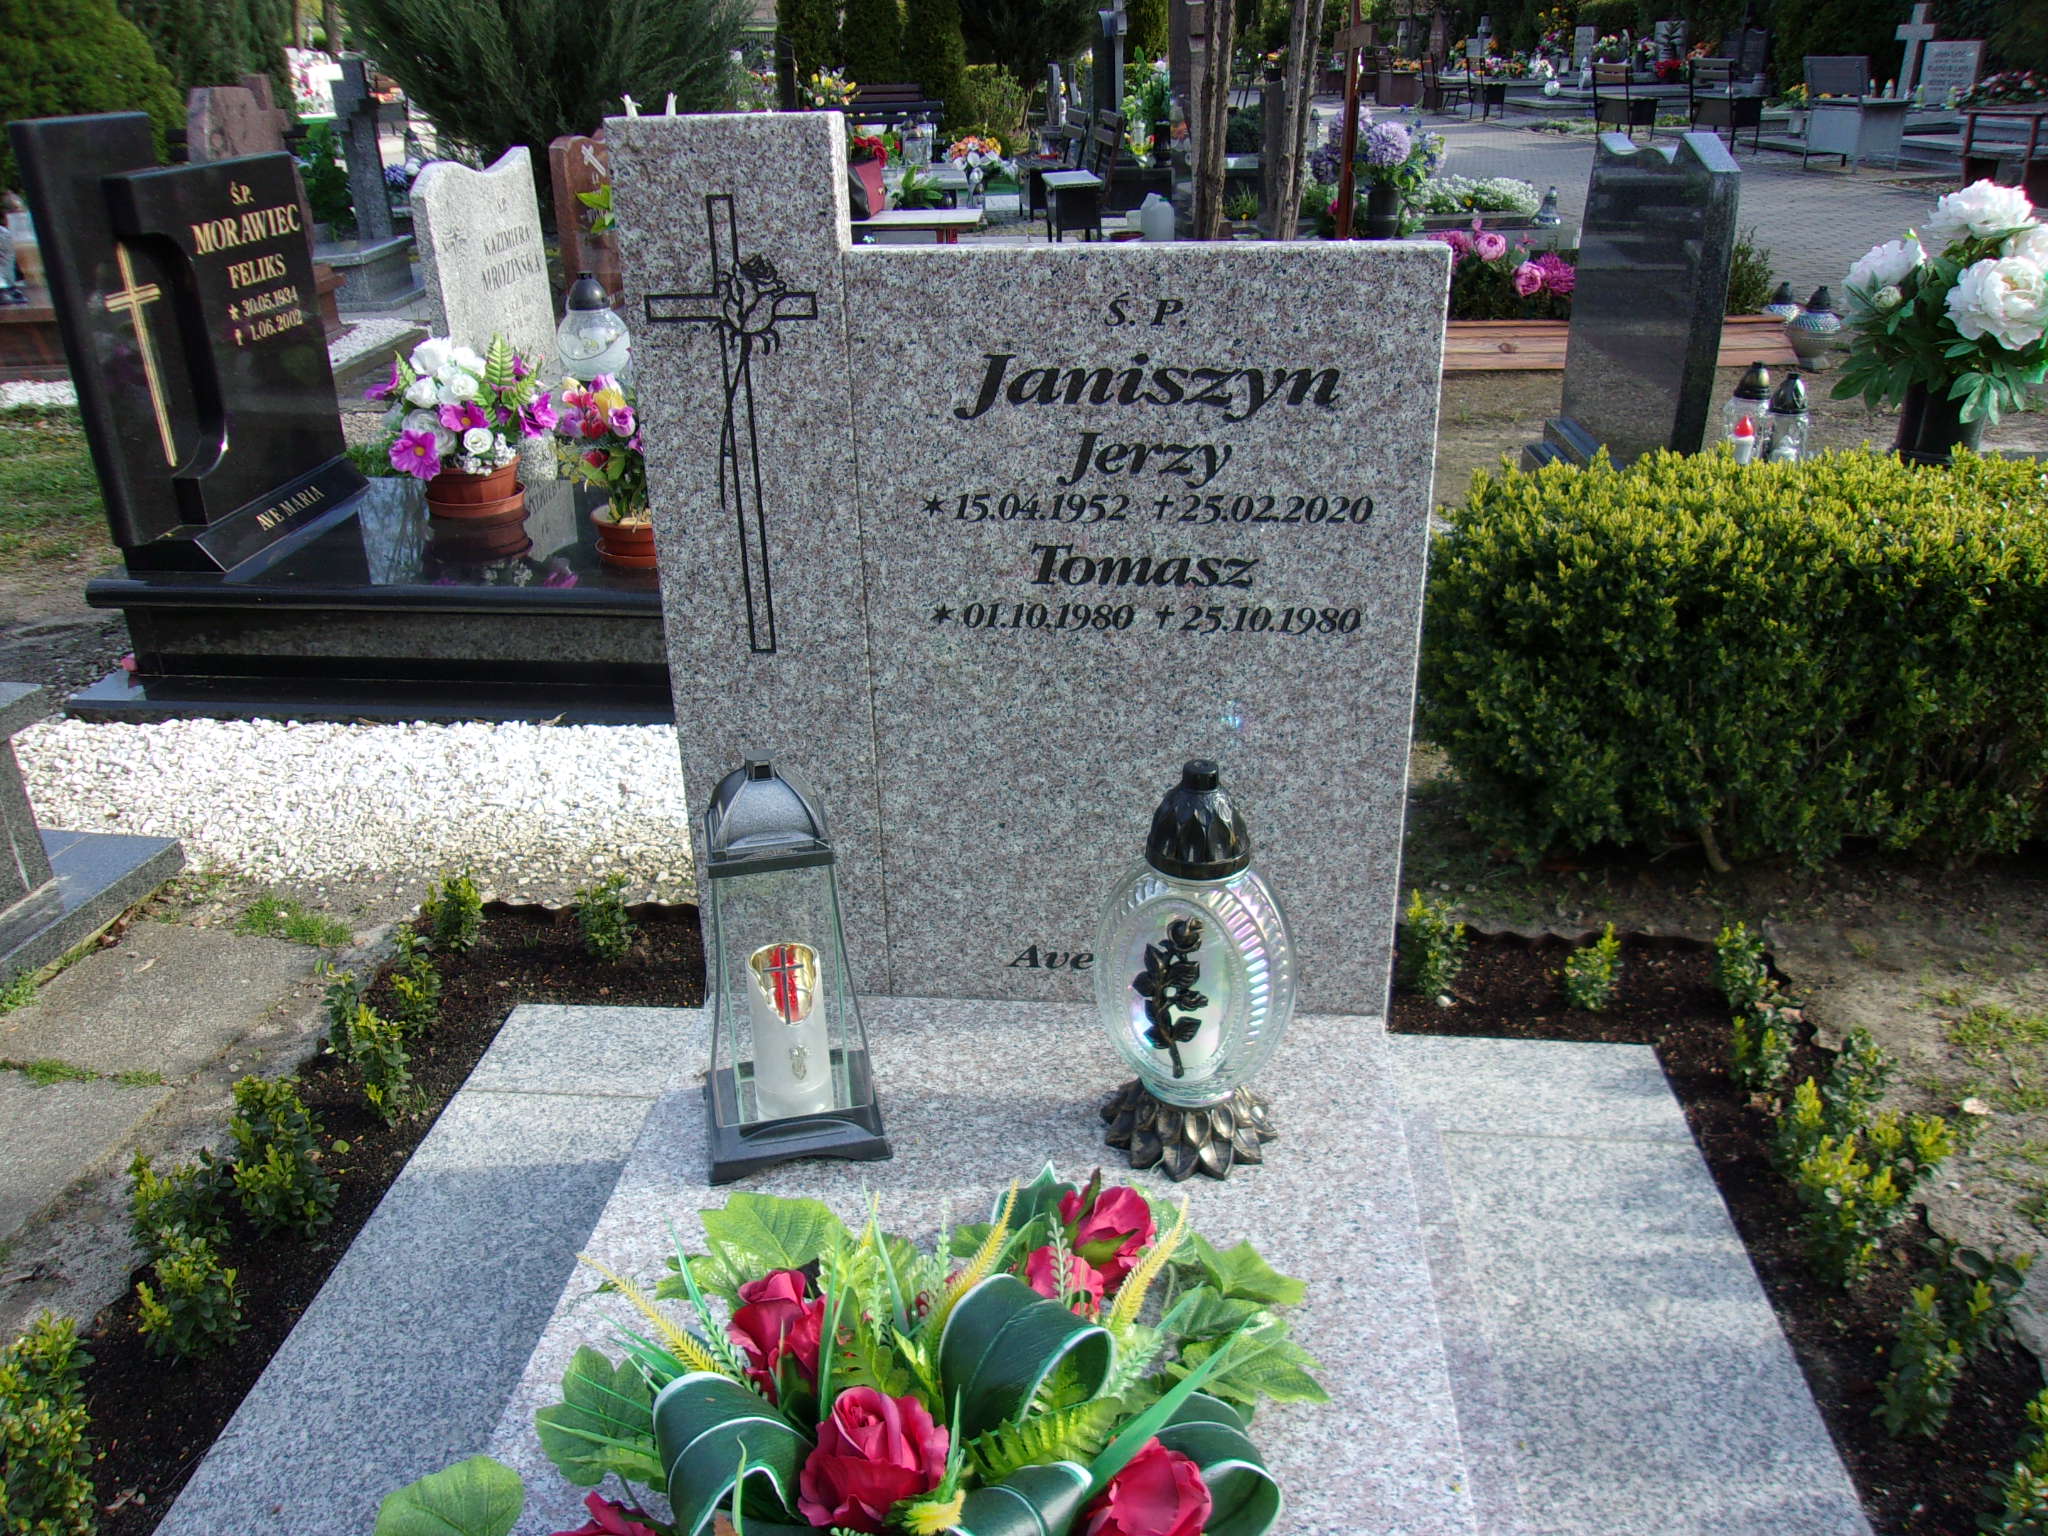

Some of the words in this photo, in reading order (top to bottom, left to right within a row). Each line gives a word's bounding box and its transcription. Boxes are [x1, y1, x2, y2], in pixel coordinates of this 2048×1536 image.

[191, 204, 301, 255] MORAWIEC
[227, 253, 287, 289] FELIKS
[249, 309, 304, 341] 1.06.2002
[953, 352, 1340, 423] Janiszyn
[1056, 432, 1233, 488] Jerzy
[256, 506, 285, 532] AVE
[278, 485, 325, 517] MARIA
[953, 493, 1130, 524] 15.04.1952
[1179, 494, 1374, 526] 25.02.2020
[1031, 543, 1260, 588] Tomasz
[962, 601, 1135, 631] 01.10.1980
[1183, 605, 1362, 635] 25.10.1980
[1005, 944, 1094, 970] Ave
